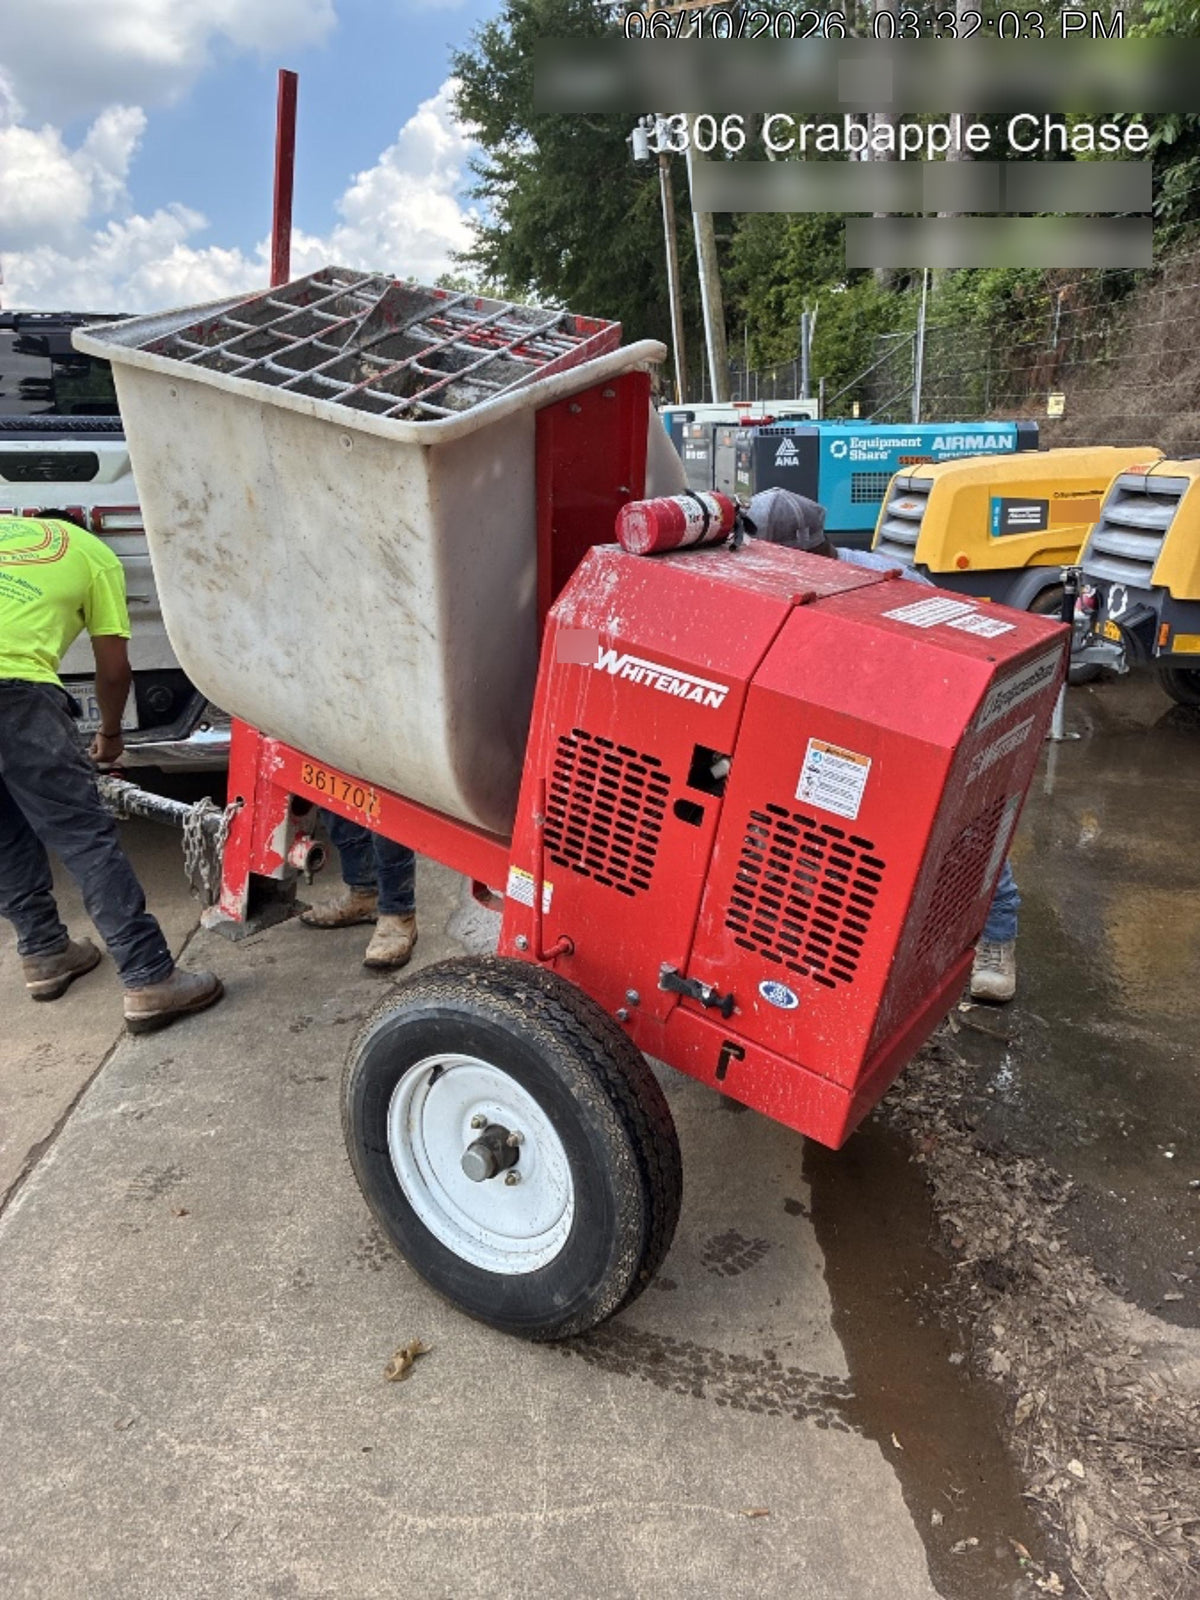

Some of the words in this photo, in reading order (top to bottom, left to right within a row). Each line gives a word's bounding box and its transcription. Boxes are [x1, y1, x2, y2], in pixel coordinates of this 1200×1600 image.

[850, 436, 922, 450] Equipment
[932, 435, 1013, 450] AIRMAN
[775, 456, 799, 466] ANA
[303, 763, 377, 813] 361707
